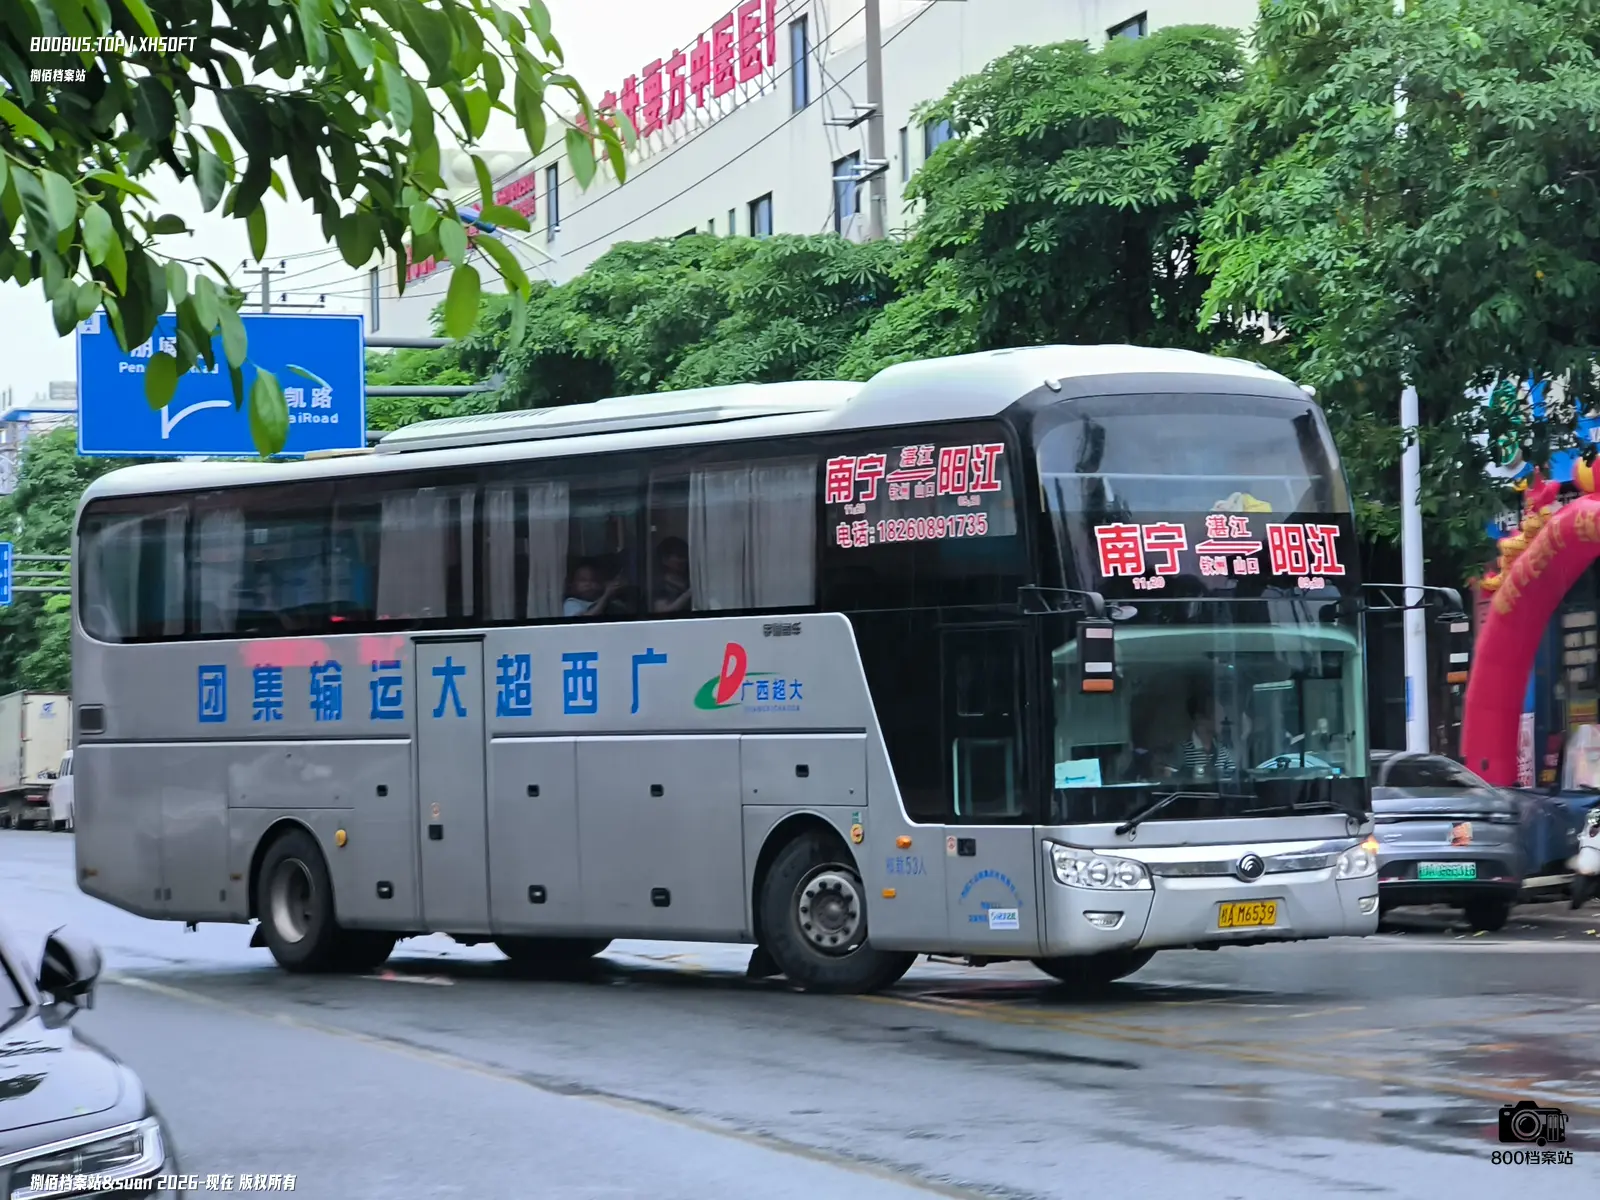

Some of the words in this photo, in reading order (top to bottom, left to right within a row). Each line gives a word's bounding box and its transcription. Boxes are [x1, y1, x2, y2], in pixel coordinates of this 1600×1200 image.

[284, 387, 332, 409] 凯路
[288, 412, 338, 424] aiRoad
[825, 453, 887, 504] 南宁
[899, 445, 935, 467] 湛江
[937, 443, 1004, 496] 阳江
[1094, 522, 1188, 577] 南宁
[1206, 514, 1252, 538] 湛江
[1266, 523, 1345, 575] 阳江
[740, 679, 803, 701] 广西超大
